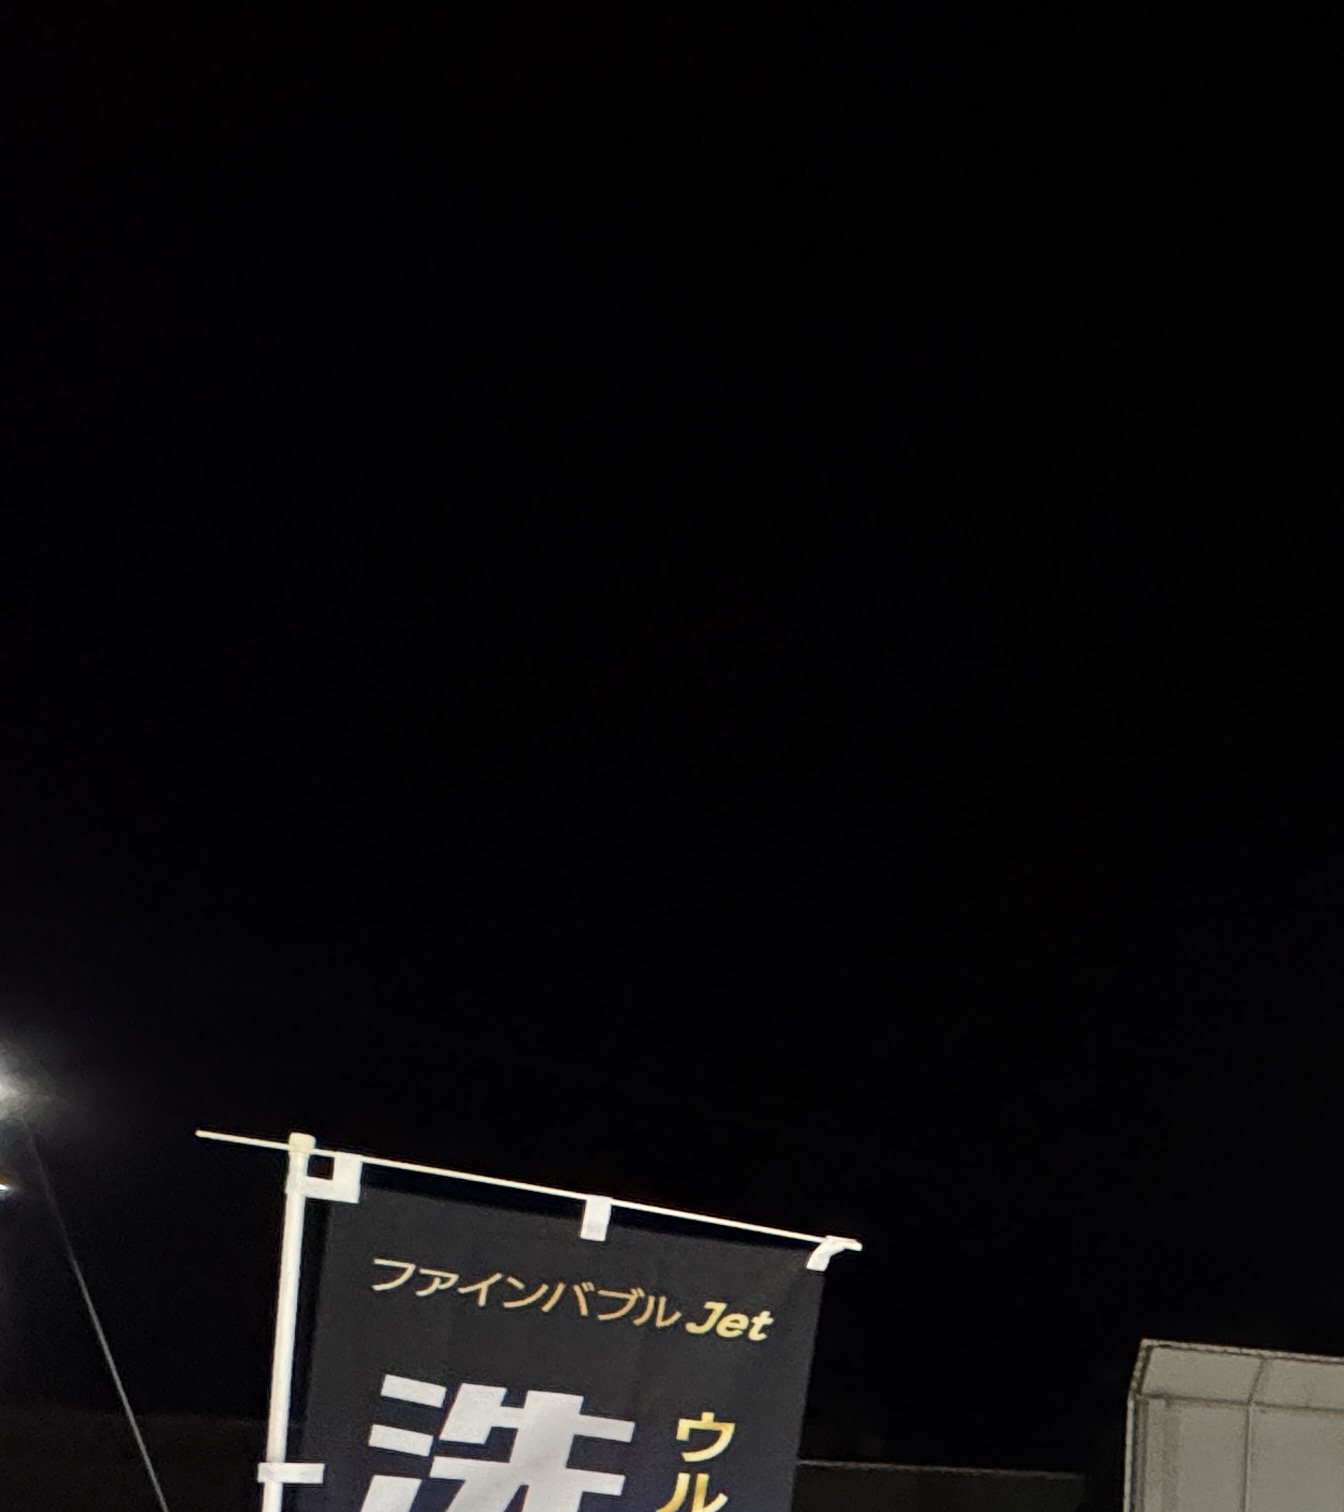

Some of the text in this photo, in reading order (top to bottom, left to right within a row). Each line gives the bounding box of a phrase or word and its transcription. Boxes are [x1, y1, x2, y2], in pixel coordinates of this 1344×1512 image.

[372, 1257, 775, 1341] ファインバブル Jet
